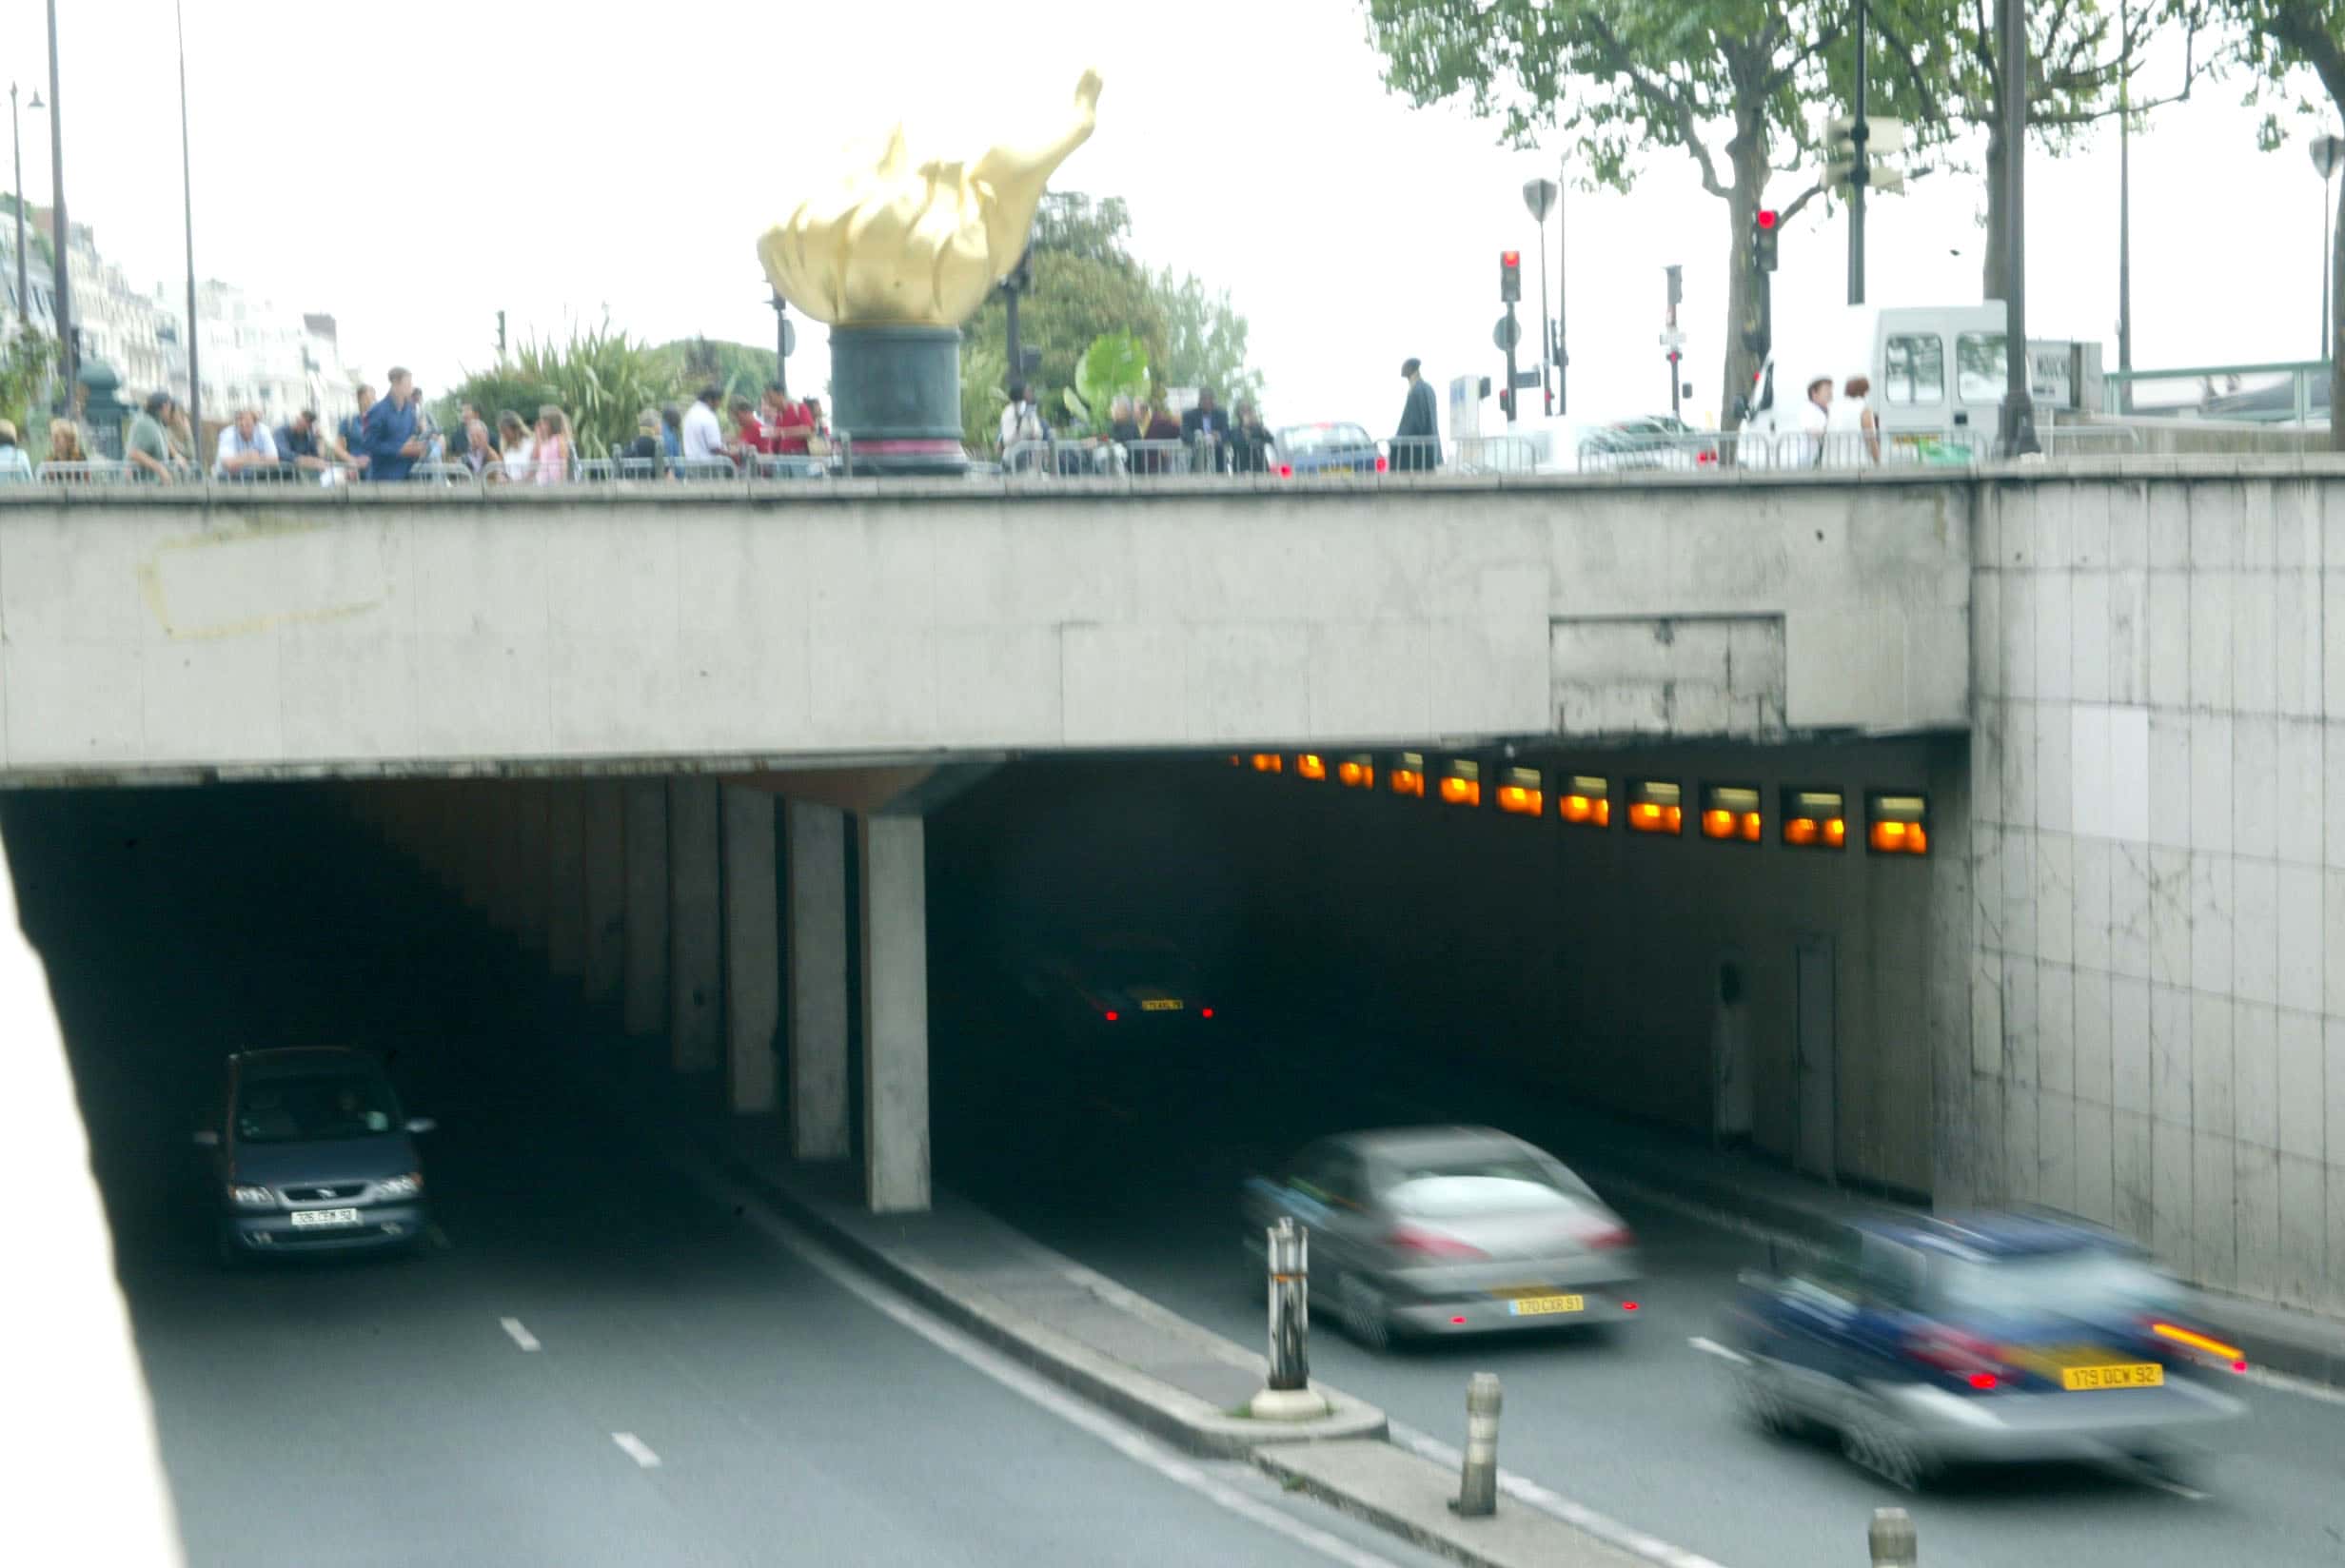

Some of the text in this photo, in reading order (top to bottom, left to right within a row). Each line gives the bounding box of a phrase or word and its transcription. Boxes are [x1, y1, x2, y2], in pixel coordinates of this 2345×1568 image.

[2073, 1365, 2157, 1386] 179 DCW 92
